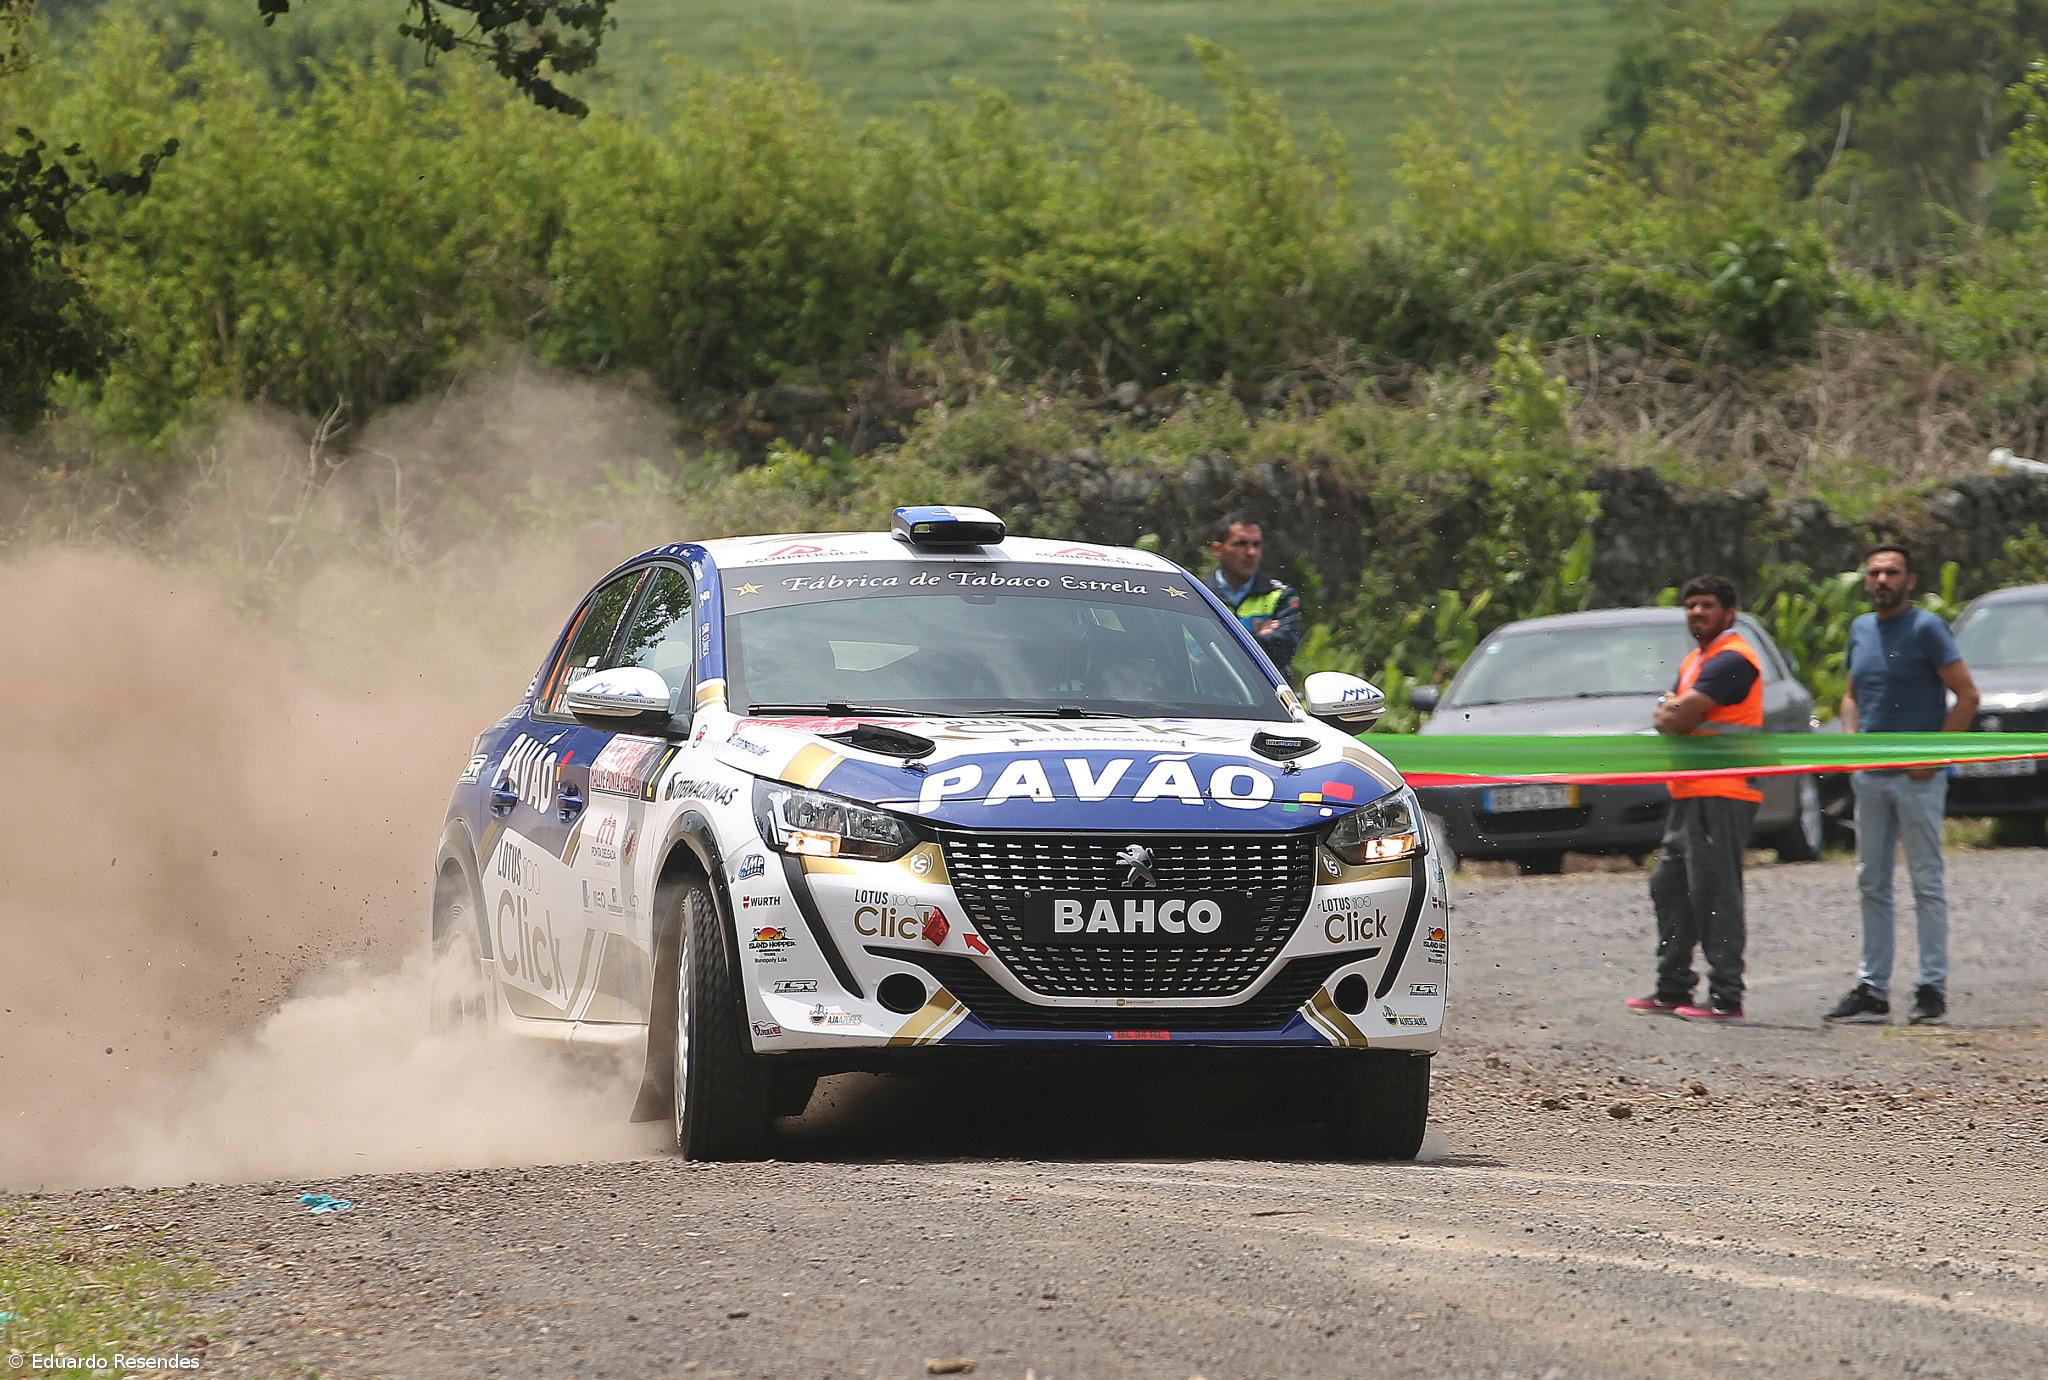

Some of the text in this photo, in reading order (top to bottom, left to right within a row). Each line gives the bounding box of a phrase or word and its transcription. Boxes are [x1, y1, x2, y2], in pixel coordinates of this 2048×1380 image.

[781, 572, 1149, 594] Fábrica de Tabaco Estrela
[490, 729, 569, 815] PAVÃO
[917, 752, 1275, 814] PAVÃO
[497, 838, 522, 885] LOTUS
[751, 896, 781, 907] WÜRTH
[854, 889, 918, 906] LOTUS 100
[1321, 897, 1351, 912] LOTUS
[1054, 899, 1223, 934] BAHCO
[1324, 908, 1389, 945] Click
[498, 888, 569, 1001] Click
[769, 941, 797, 949] HOPPER
